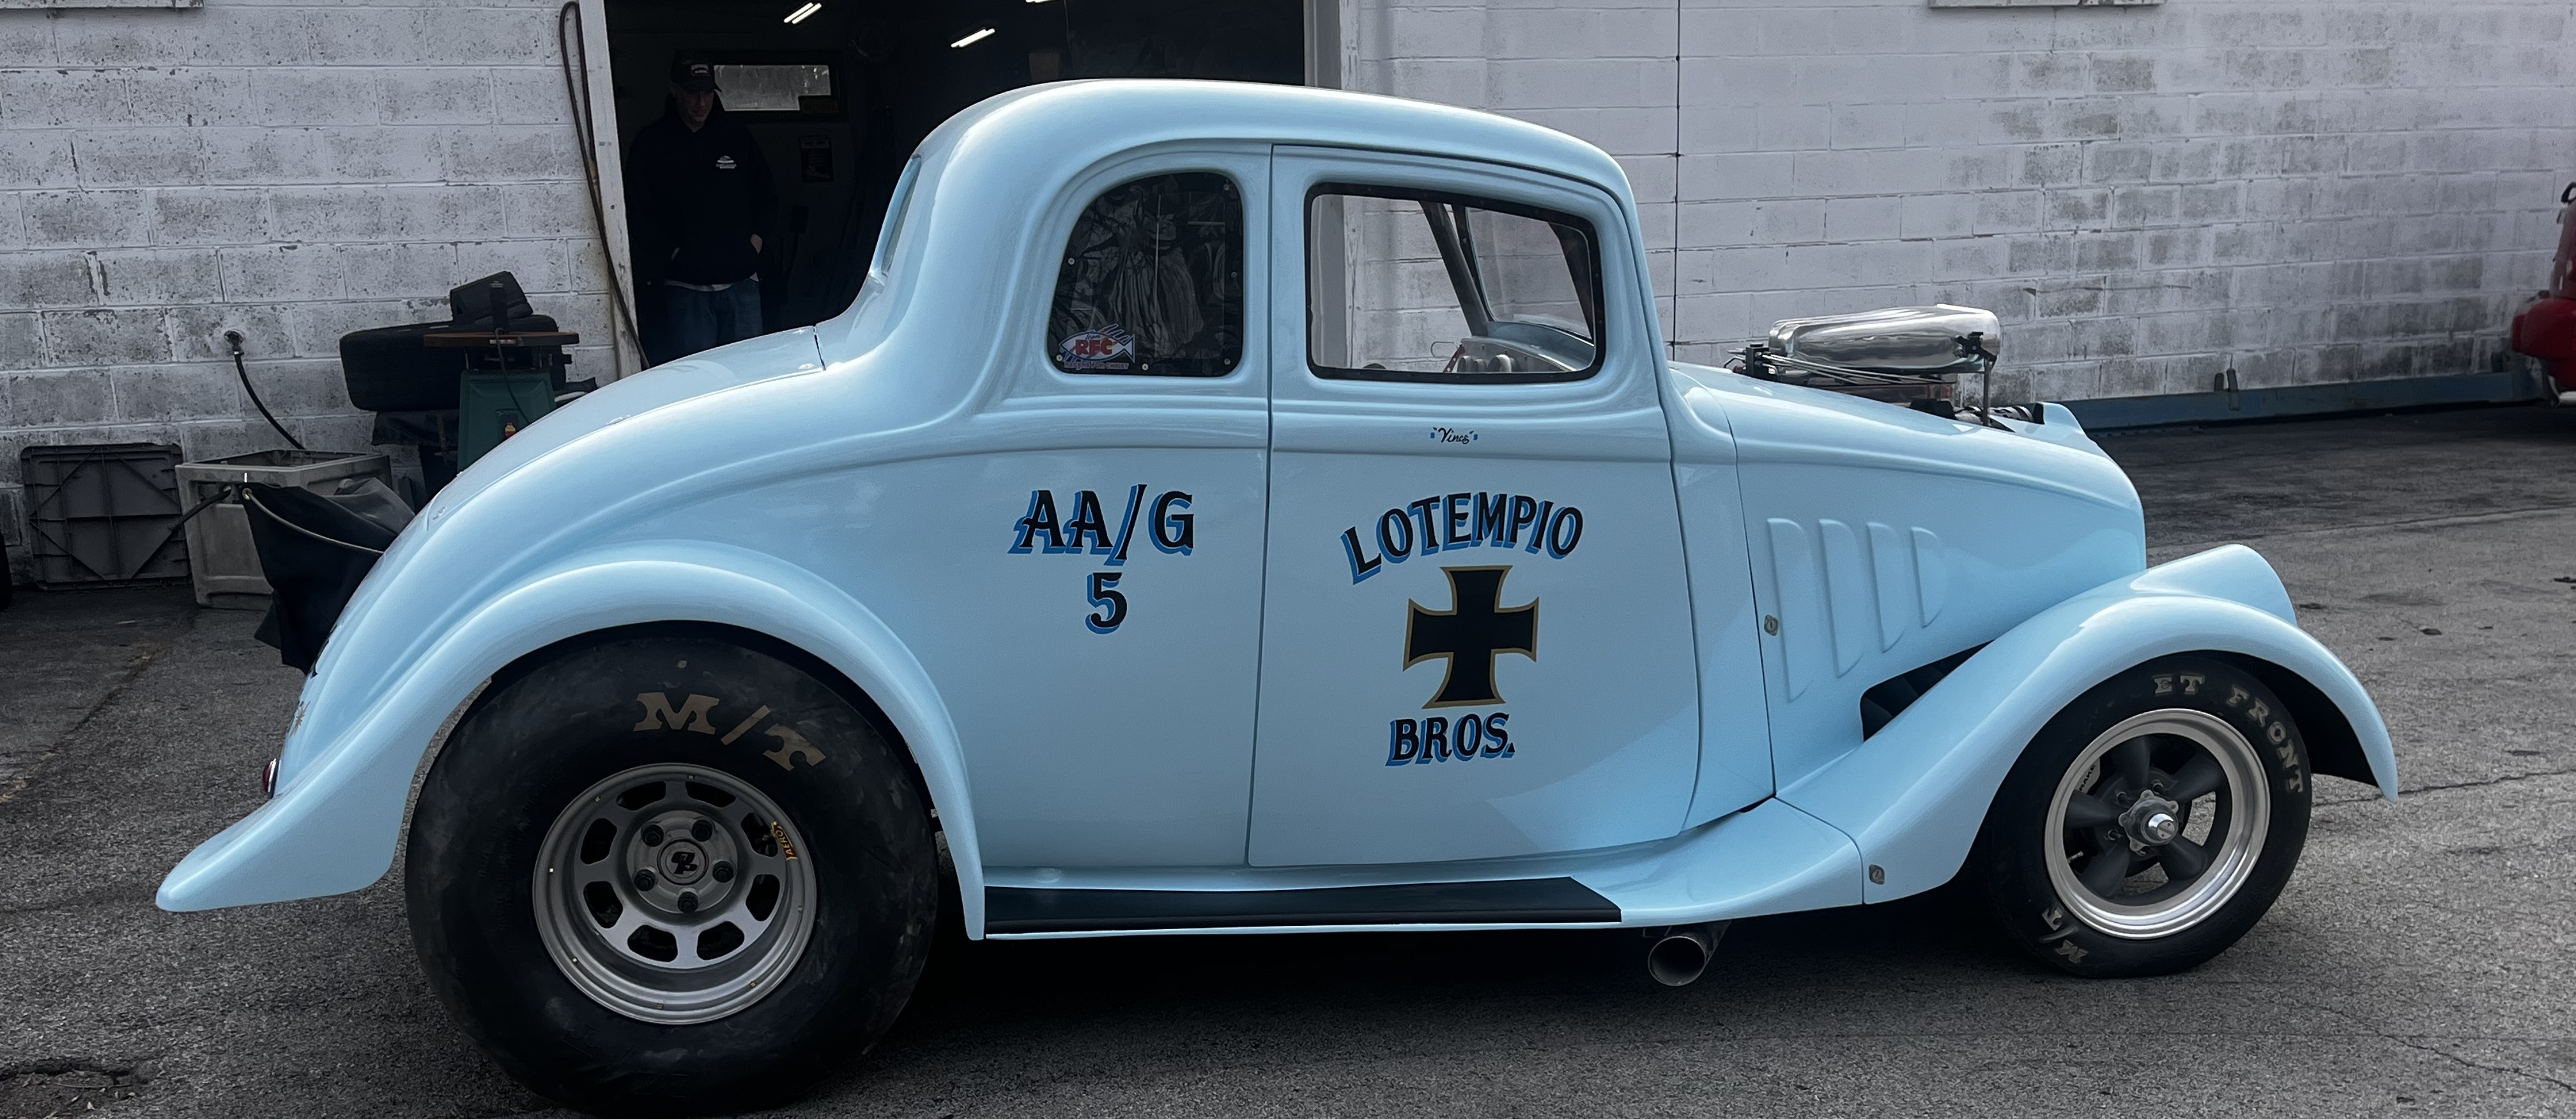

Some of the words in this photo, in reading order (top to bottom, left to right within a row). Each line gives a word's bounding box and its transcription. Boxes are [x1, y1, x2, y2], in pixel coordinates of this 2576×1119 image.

[1075, 339, 1112, 355] RFC
[1008, 484, 1194, 566] AA/G
[1340, 491, 1583, 585] LOTEMPIO
[1085, 572, 1128, 635] 5
[633, 691, 826, 771] M/T
[1385, 712, 1515, 766] BROS.
[2153, 674, 2205, 695] ET
[2227, 686, 2304, 793] FRONT
[776, 830, 794, 856] AERO
